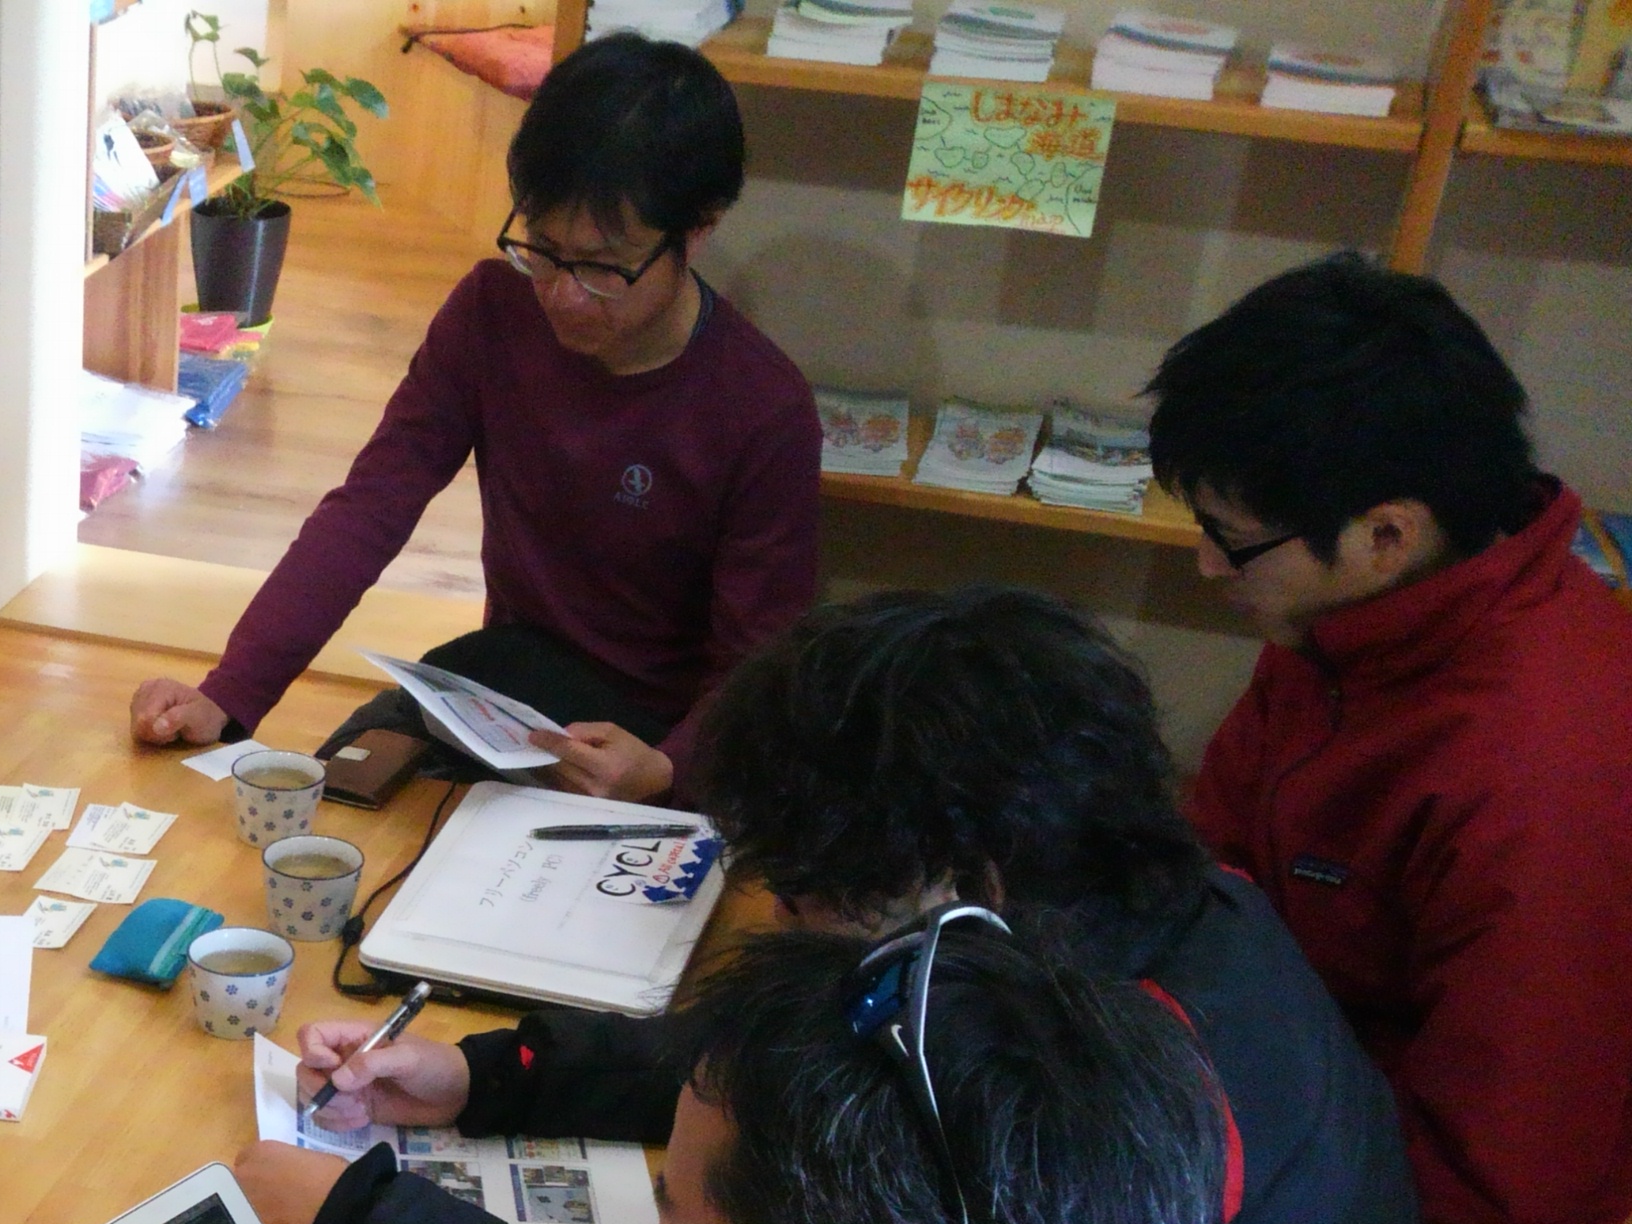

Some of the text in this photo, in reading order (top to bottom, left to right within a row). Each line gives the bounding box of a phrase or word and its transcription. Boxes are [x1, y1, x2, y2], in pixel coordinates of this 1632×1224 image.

[970, 90, 1088, 128] しまなみ
[1028, 126, 1105, 161] 海道
[479, 840, 534, 907] フリーパソコン
